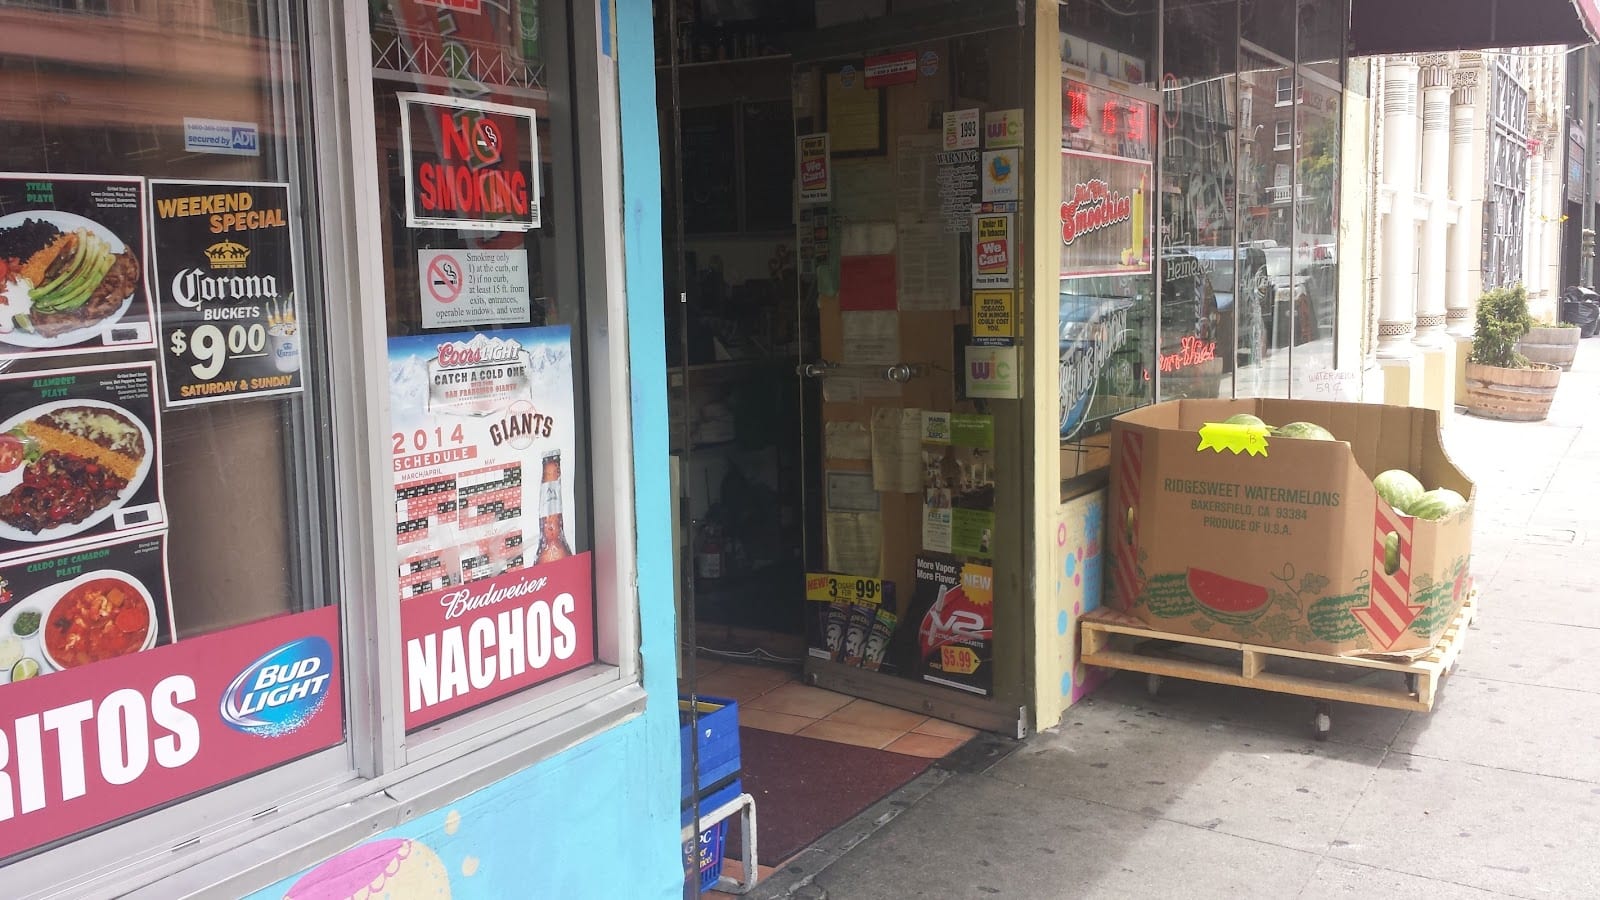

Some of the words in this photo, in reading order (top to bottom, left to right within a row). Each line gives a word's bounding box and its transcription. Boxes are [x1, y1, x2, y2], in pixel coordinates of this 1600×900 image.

[188, 135, 219, 144] secured
[221, 136, 230, 146] by
[233, 131, 255, 147] ADT
[441, 113, 502, 163] NO
[419, 162, 528, 215] SMOKING
[157, 192, 253, 219] WEEKEND
[209, 208, 286, 234] SPECIAL
[983, 242, 1001, 254] We
[466, 252, 495, 264] Smoking
[496, 252, 510, 264] only
[979, 252, 1006, 266] Card
[469, 265, 475, 276] 1)
[484, 264, 493, 273] the
[495, 264, 510, 274] curb,
[1165, 258, 1216, 282] Heineken
[171, 268, 280, 312] Corona
[469, 277, 475, 287] 2)
[477, 276, 483, 284] if
[493, 275, 509, 284] curb,
[477, 286, 491, 294] least
[510, 285, 524, 293] from
[470, 297, 486, 306] exits,
[488, 296, 519, 305] entrances,
[204, 306, 260, 321] BUCKETS
[435, 309, 464, 319] operable
[497, 306, 508, 315] and
[510, 305, 525, 315] vents
[438, 343, 480, 367] Coors
[480, 344, 520, 362] LIGHT
[180, 380, 237, 397] SATURDAY
[239, 379, 248, 390] &
[250, 374, 293, 390] SUNDAY
[435, 374, 468, 386] CATCH
[471, 370, 478, 382] A
[480, 368, 503, 380] COLD
[41, 388, 68, 398] PLATE
[490, 412, 555, 447] GIANTS
[392, 424, 464, 455] 2014
[394, 448, 470, 471] SCHEDULE
[1164, 478, 1240, 499] RIDGESWEET
[1245, 486, 1340, 508] WATERMELONS
[1191, 499, 1254, 518] BAKERSFIELD,
[1257, 507, 1270, 517] CA
[1276, 508, 1307, 521] 93384
[1203, 517, 1246, 530] PRODUCE
[1249, 521, 1261, 532] OF
[1264, 523, 1292, 536] U.S.A.
[27, 560, 55, 573] CALDO
[57, 556, 68, 566] DE
[56, 565, 82, 578] PLATE
[916, 558, 934, 571] More
[935, 561, 957, 574] Vapor.
[916, 569, 934, 581] More
[934, 572, 957, 585] Flavor.
[963, 572, 991, 592] NEW
[828, 579, 837, 597] 3
[440, 576, 546, 620] Budweiser
[407, 592, 577, 713] NACHOS
[943, 649, 971, 669] $5.99
[254, 656, 321, 691] BUD
[238, 673, 329, 718] LIGHT
